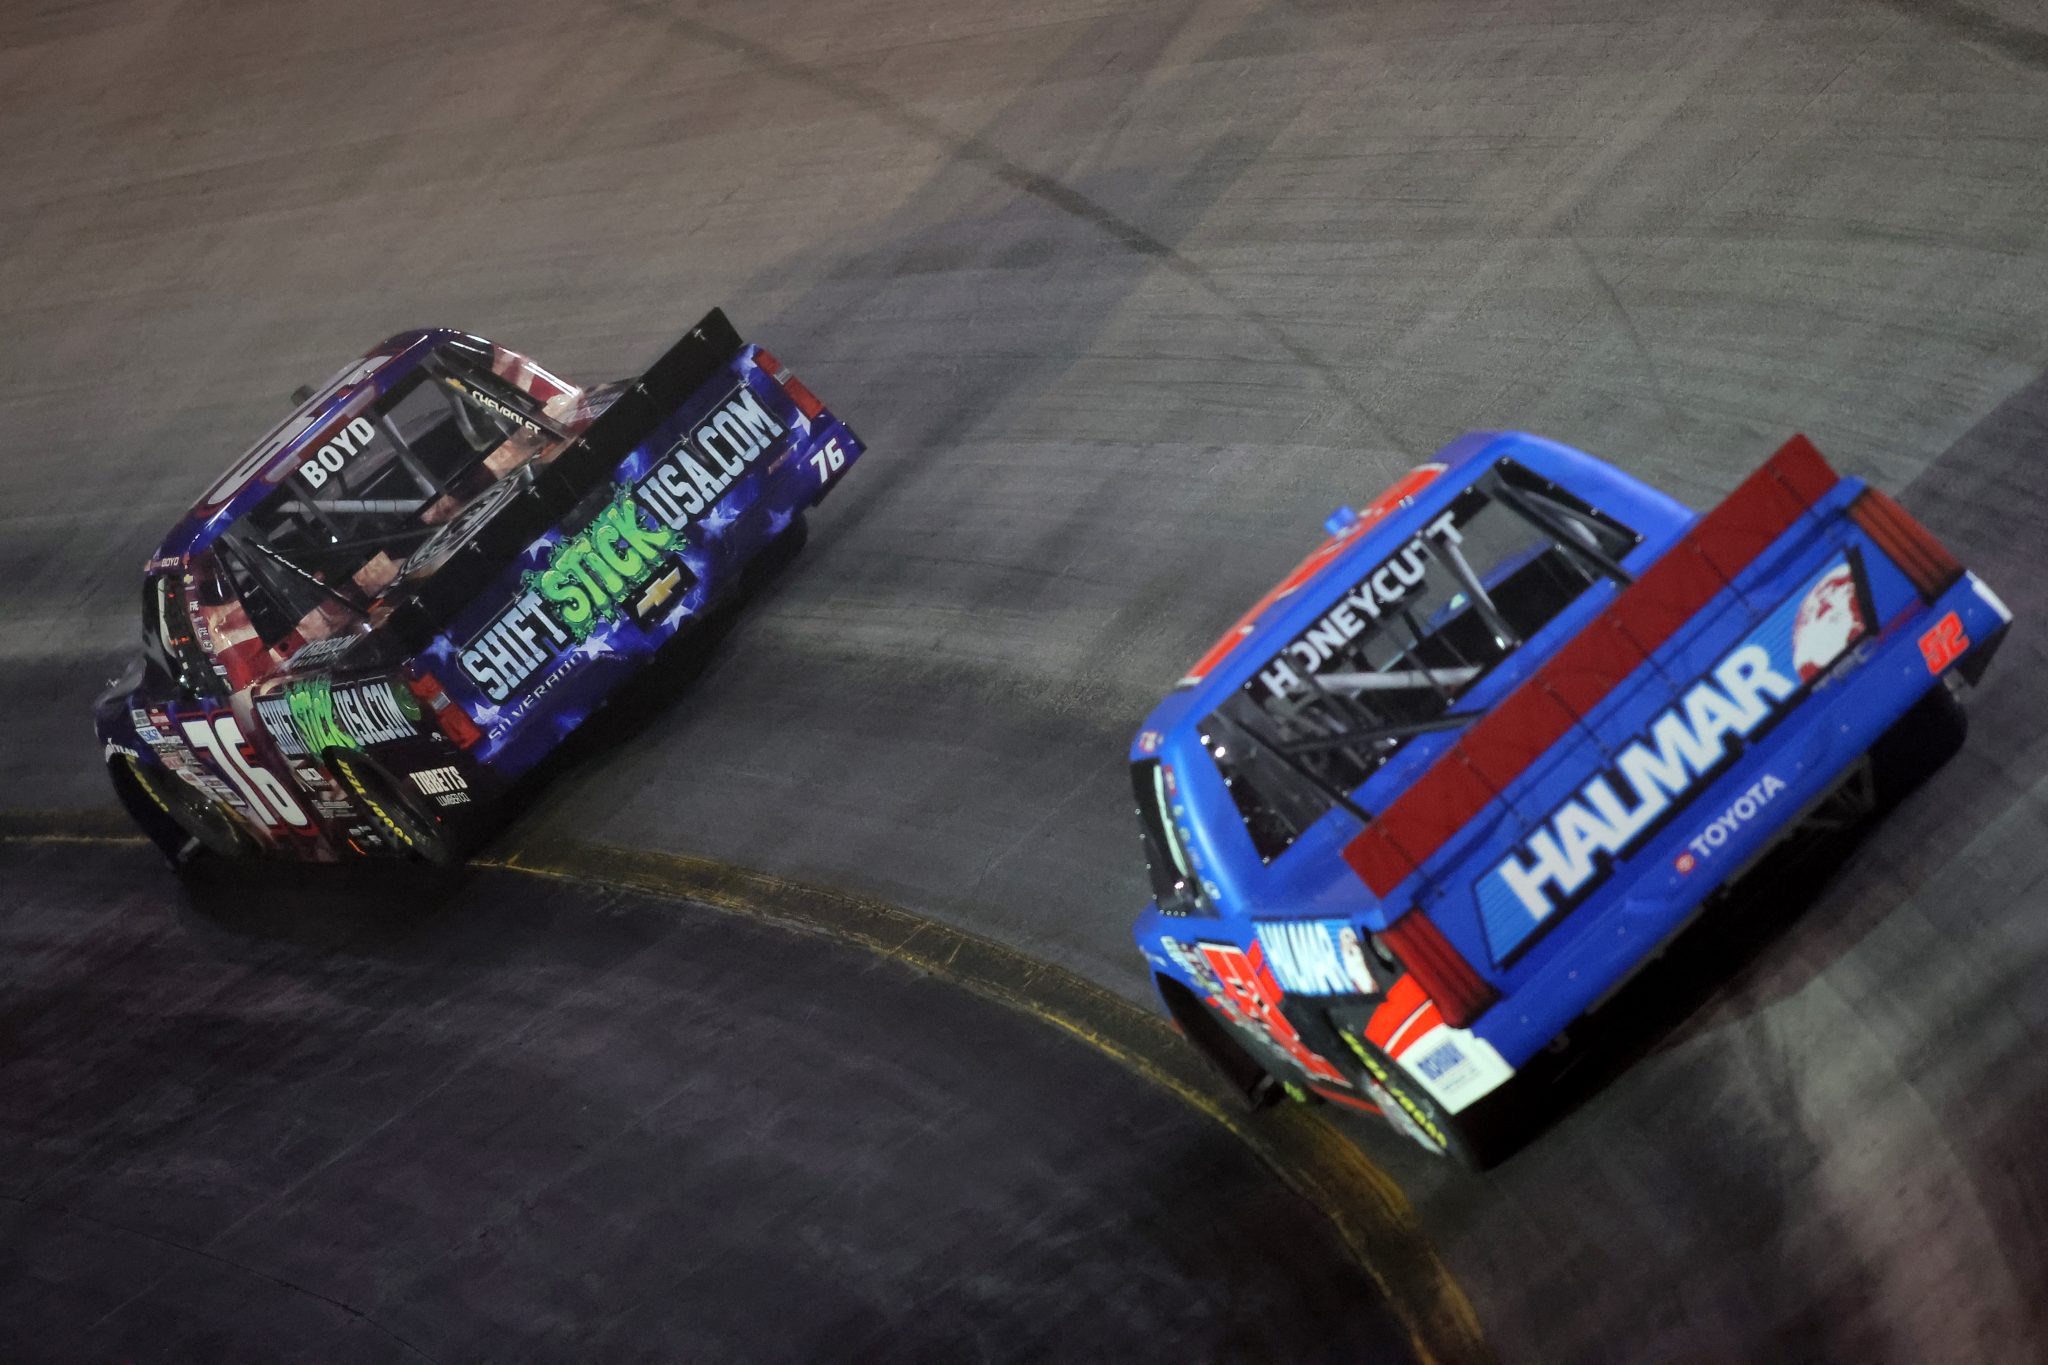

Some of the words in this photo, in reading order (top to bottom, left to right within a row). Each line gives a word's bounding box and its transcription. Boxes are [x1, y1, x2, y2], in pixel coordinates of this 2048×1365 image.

[300, 416, 375, 489] BOYD
[810, 438, 846, 484] 76
[461, 591, 568, 701] SHIFT
[541, 499, 673, 623] STICK
[637, 388, 789, 531] USA.COM
[1260, 510, 1464, 700] HONEYCUT
[1918, 611, 1971, 676] 52
[181, 716, 308, 827] 76
[409, 766, 468, 795] TIBBETTS
[1500, 644, 1801, 922] HALMAR
[1691, 773, 1787, 858] TOYOTA
